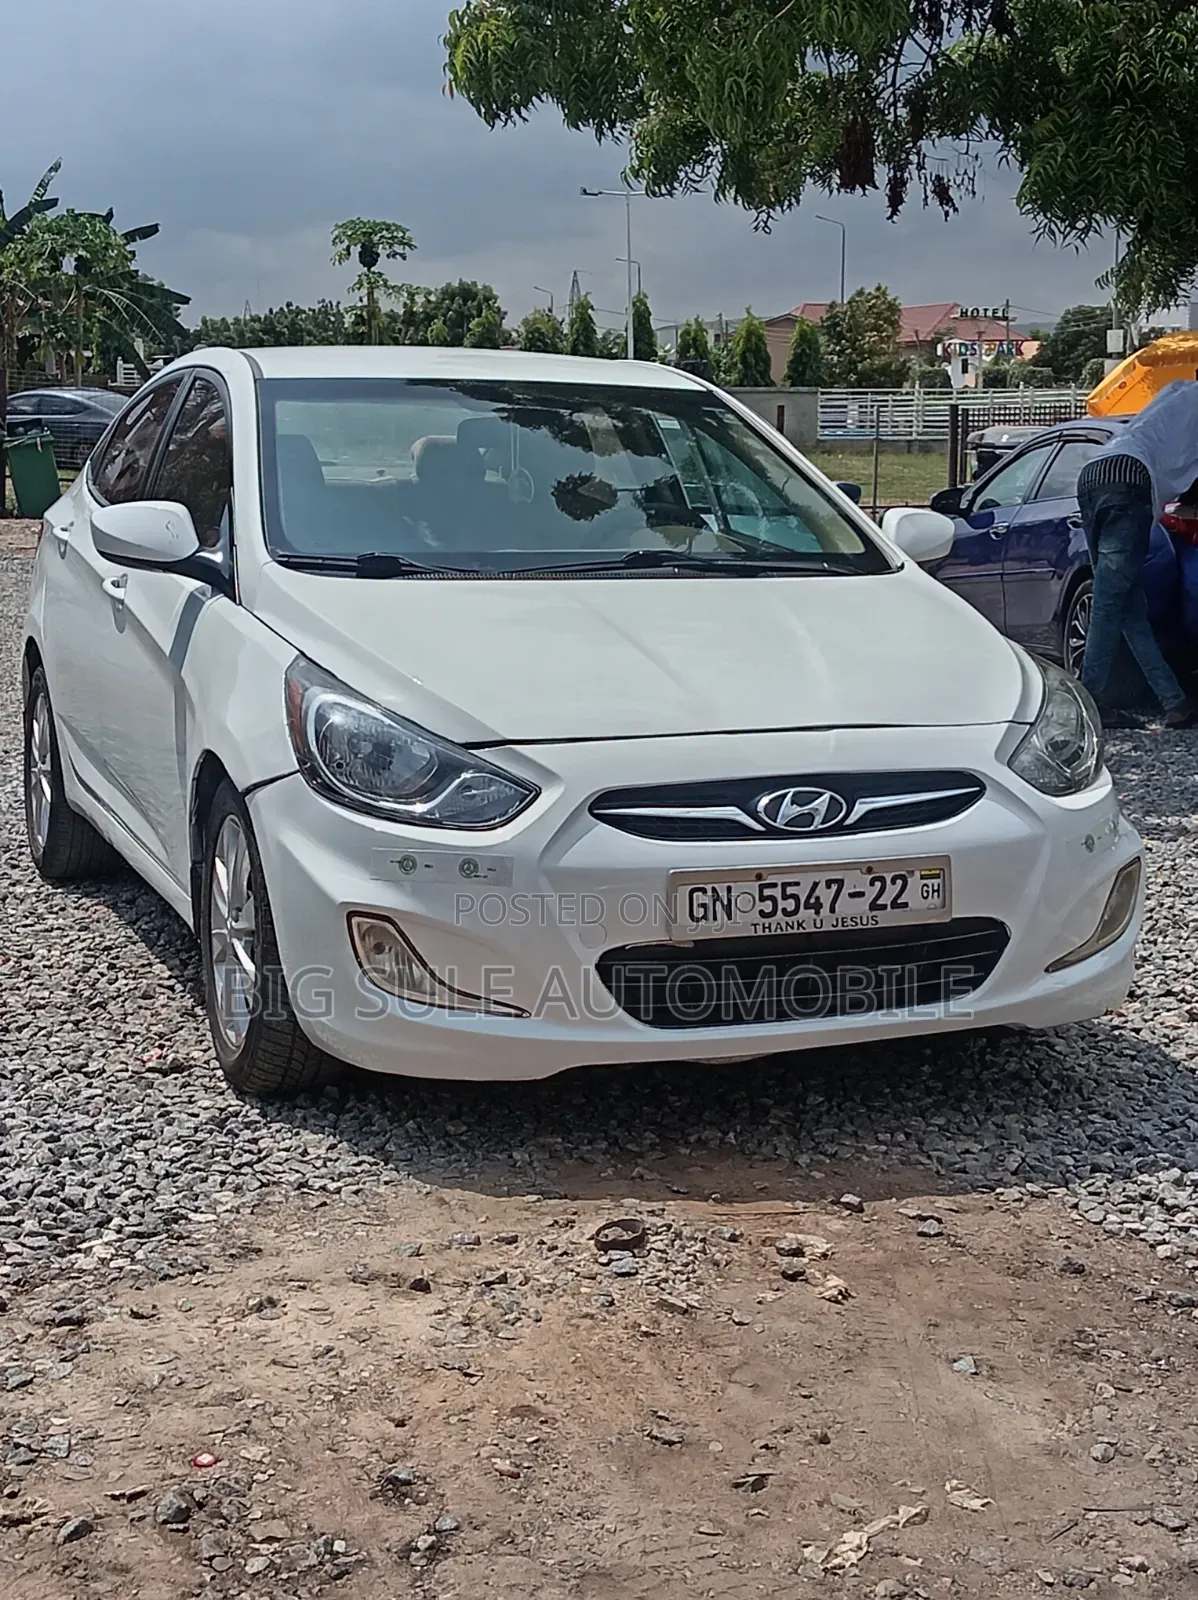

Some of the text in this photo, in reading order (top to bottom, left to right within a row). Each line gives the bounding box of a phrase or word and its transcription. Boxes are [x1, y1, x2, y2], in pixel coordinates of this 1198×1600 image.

[960, 307, 1009, 318] HOTEL
[942, 340, 1024, 357] KIDS PARK
[688, 874, 910, 923] GN 5547-22
[921, 882, 941, 900] GH
[751, 914, 879, 934] THANK U JESUS
